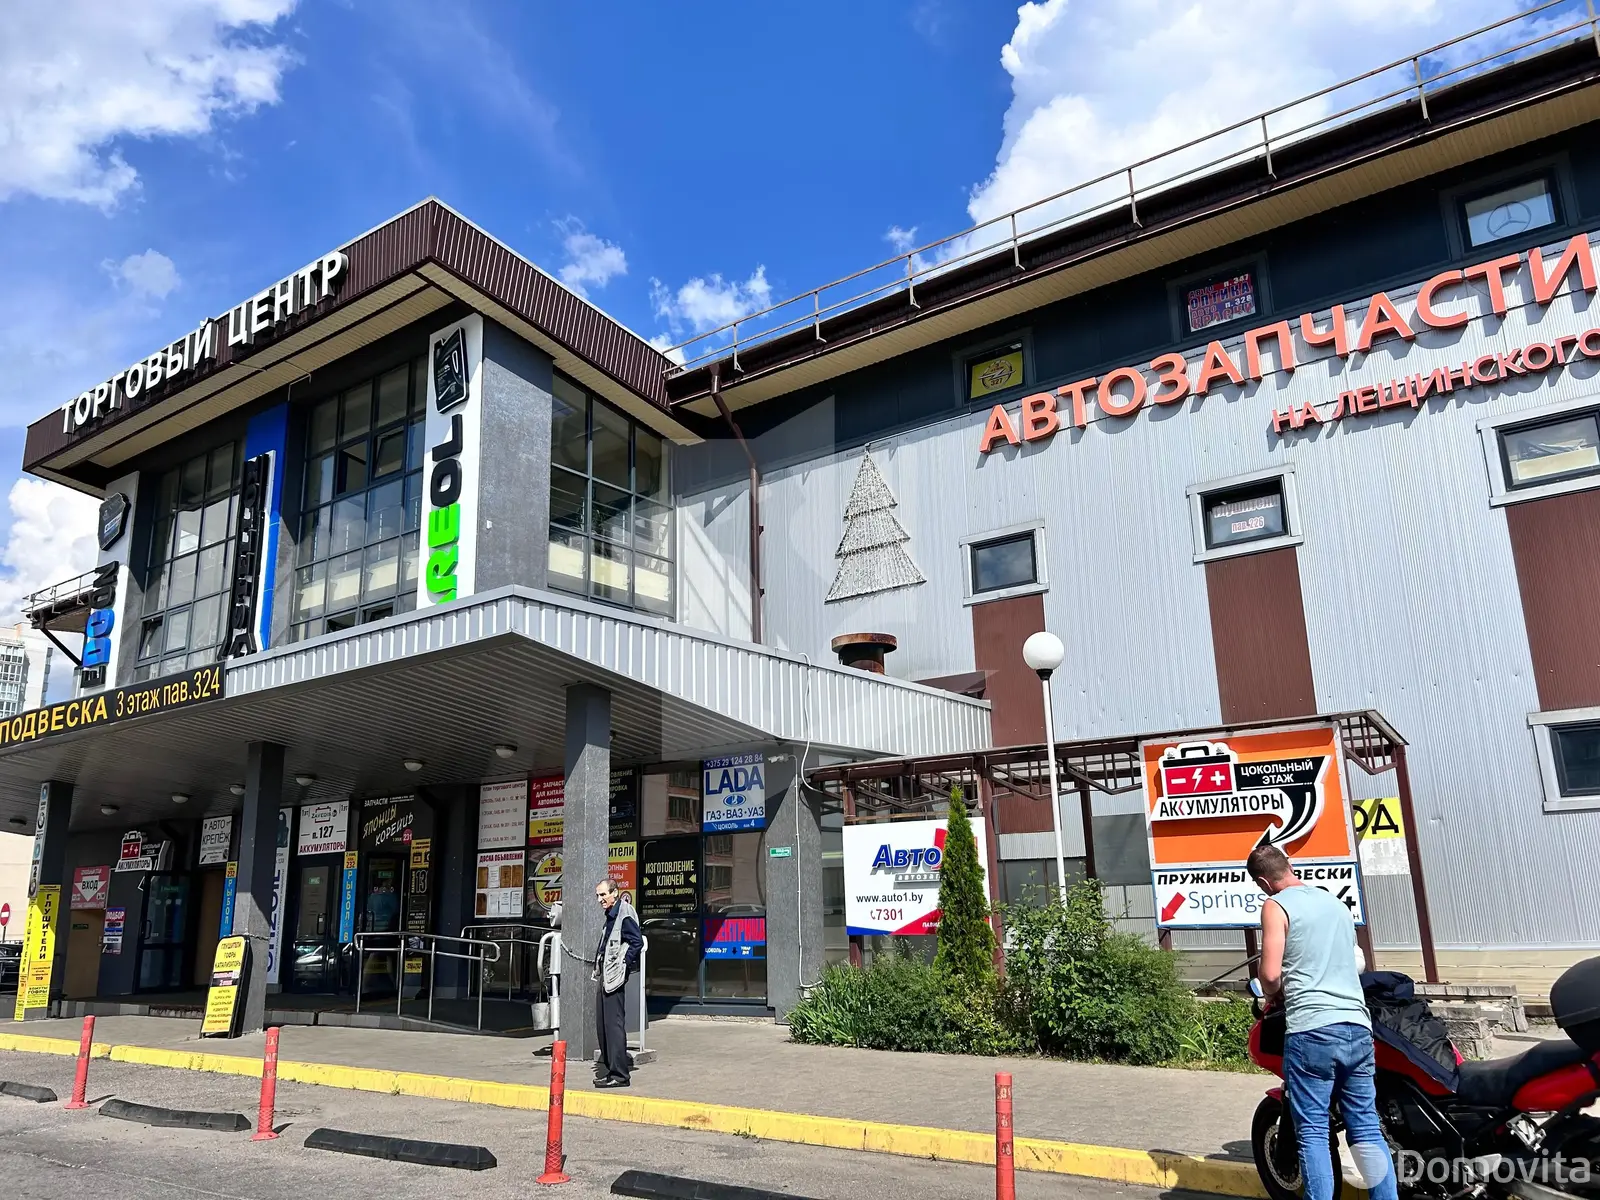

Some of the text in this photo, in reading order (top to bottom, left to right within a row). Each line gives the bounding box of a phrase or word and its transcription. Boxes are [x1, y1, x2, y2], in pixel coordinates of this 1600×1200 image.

[1190, 281, 1251, 310] ОПТИКА
[61, 251, 348, 434] ТОРГОВЫЙ ЦЕНТР
[979, 233, 1597, 453] АВТОЗАПЧАСТИ
[1272, 328, 1600, 434] НА ЛЕЩИНСКОГО
[0, 695, 108, 744] ПОДВЕСКА
[116, 691, 124, 717] 3
[127, 687, 160, 716] этаж
[731, 756, 743, 765] 124
[744, 755, 753, 763] 28
[755, 753, 763, 762] 84
[1240, 759, 1314, 776] ЦОКОЛЬНЫЙ
[705, 766, 764, 795] LADA
[1262, 774, 1294, 785] ЭТАЖ
[299, 841, 346, 853] АККУМУЛЯТОРЫ
[645, 859, 695, 874] ИЗГОТОВЛЕНИЕ
[656, 872, 684, 886] КЛЮЧЕЙ
[1157, 872, 1246, 885] ПРУЖИНЫ
[544, 890, 561, 903] 327
[856, 892, 923, 904] www.auto1.by
[876, 909, 903, 920] 7301
